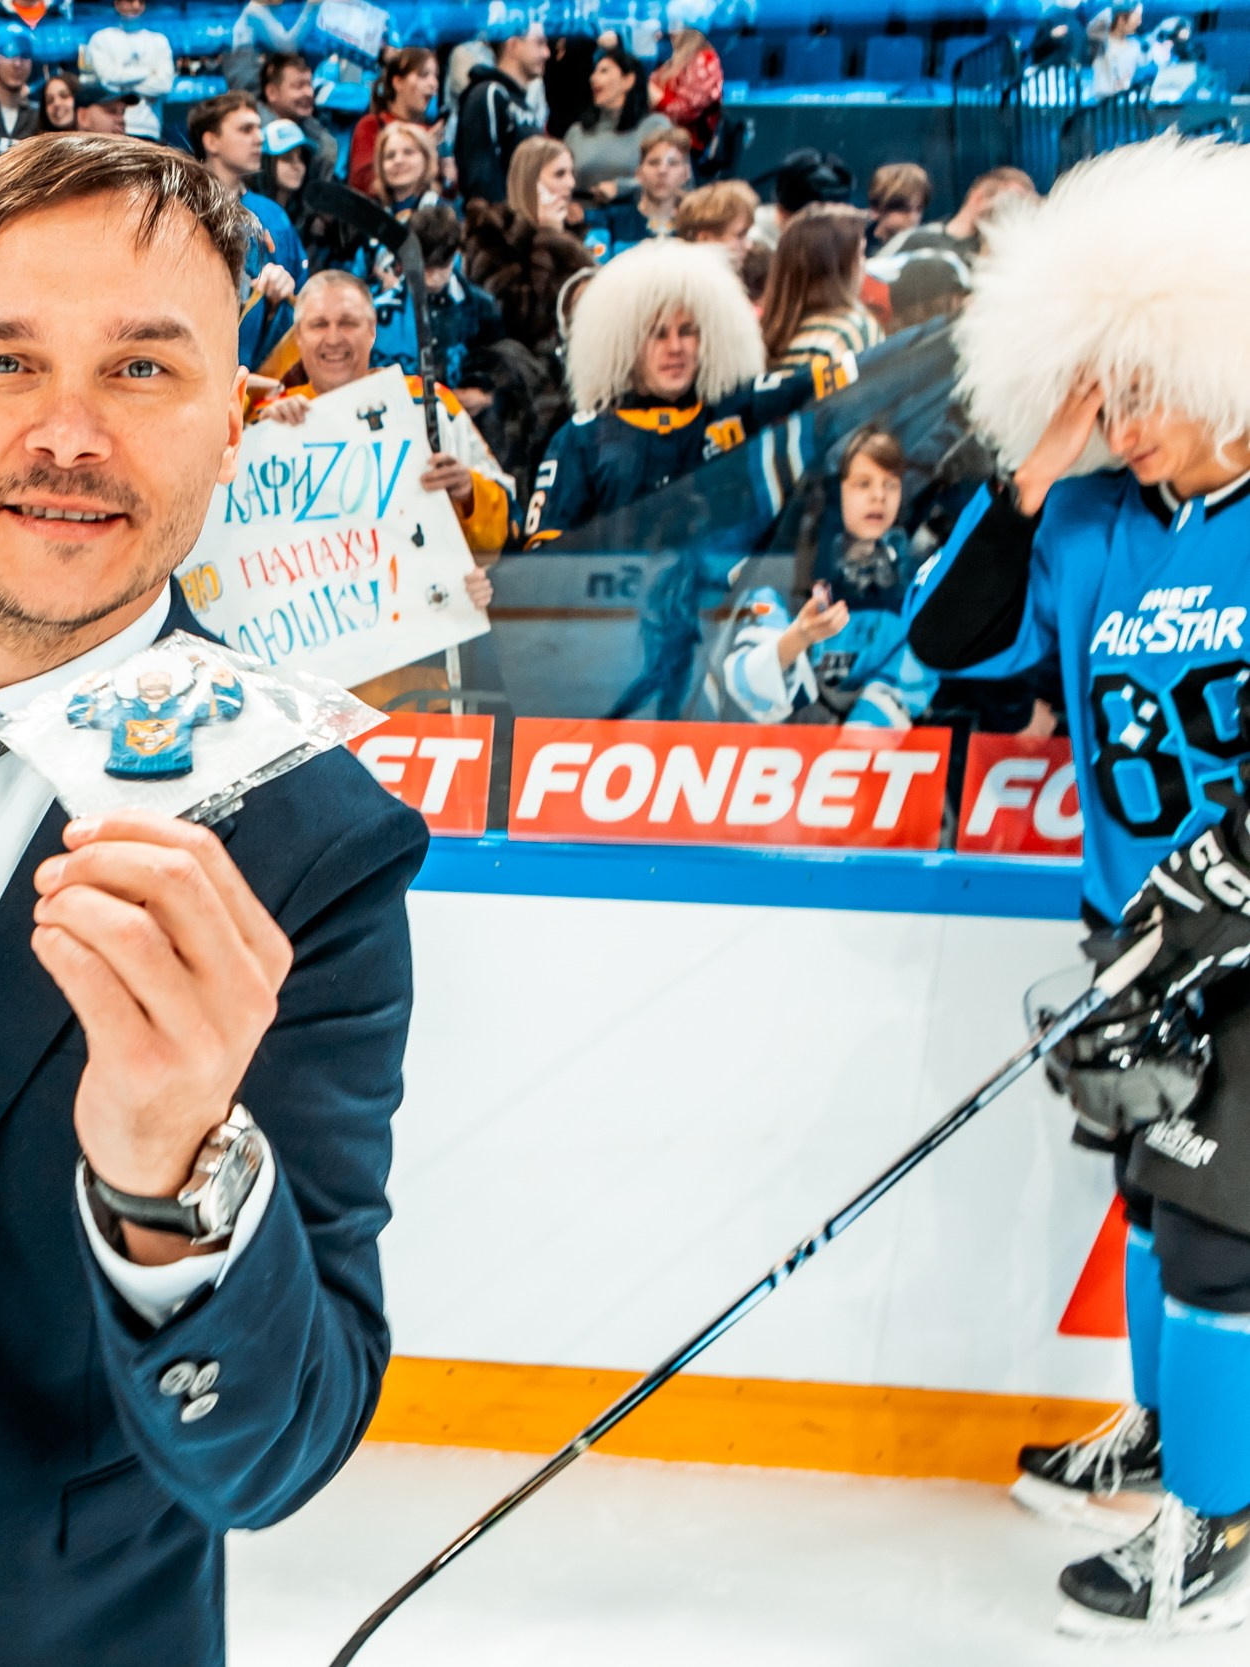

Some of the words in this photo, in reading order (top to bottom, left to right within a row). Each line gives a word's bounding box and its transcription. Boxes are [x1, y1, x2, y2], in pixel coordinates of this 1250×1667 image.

[238, 528, 379, 589] ПАПАХУ
[356, 735, 484, 815] ET
[515, 742, 939, 830] FONBET
[964, 758, 1084, 840] FO
